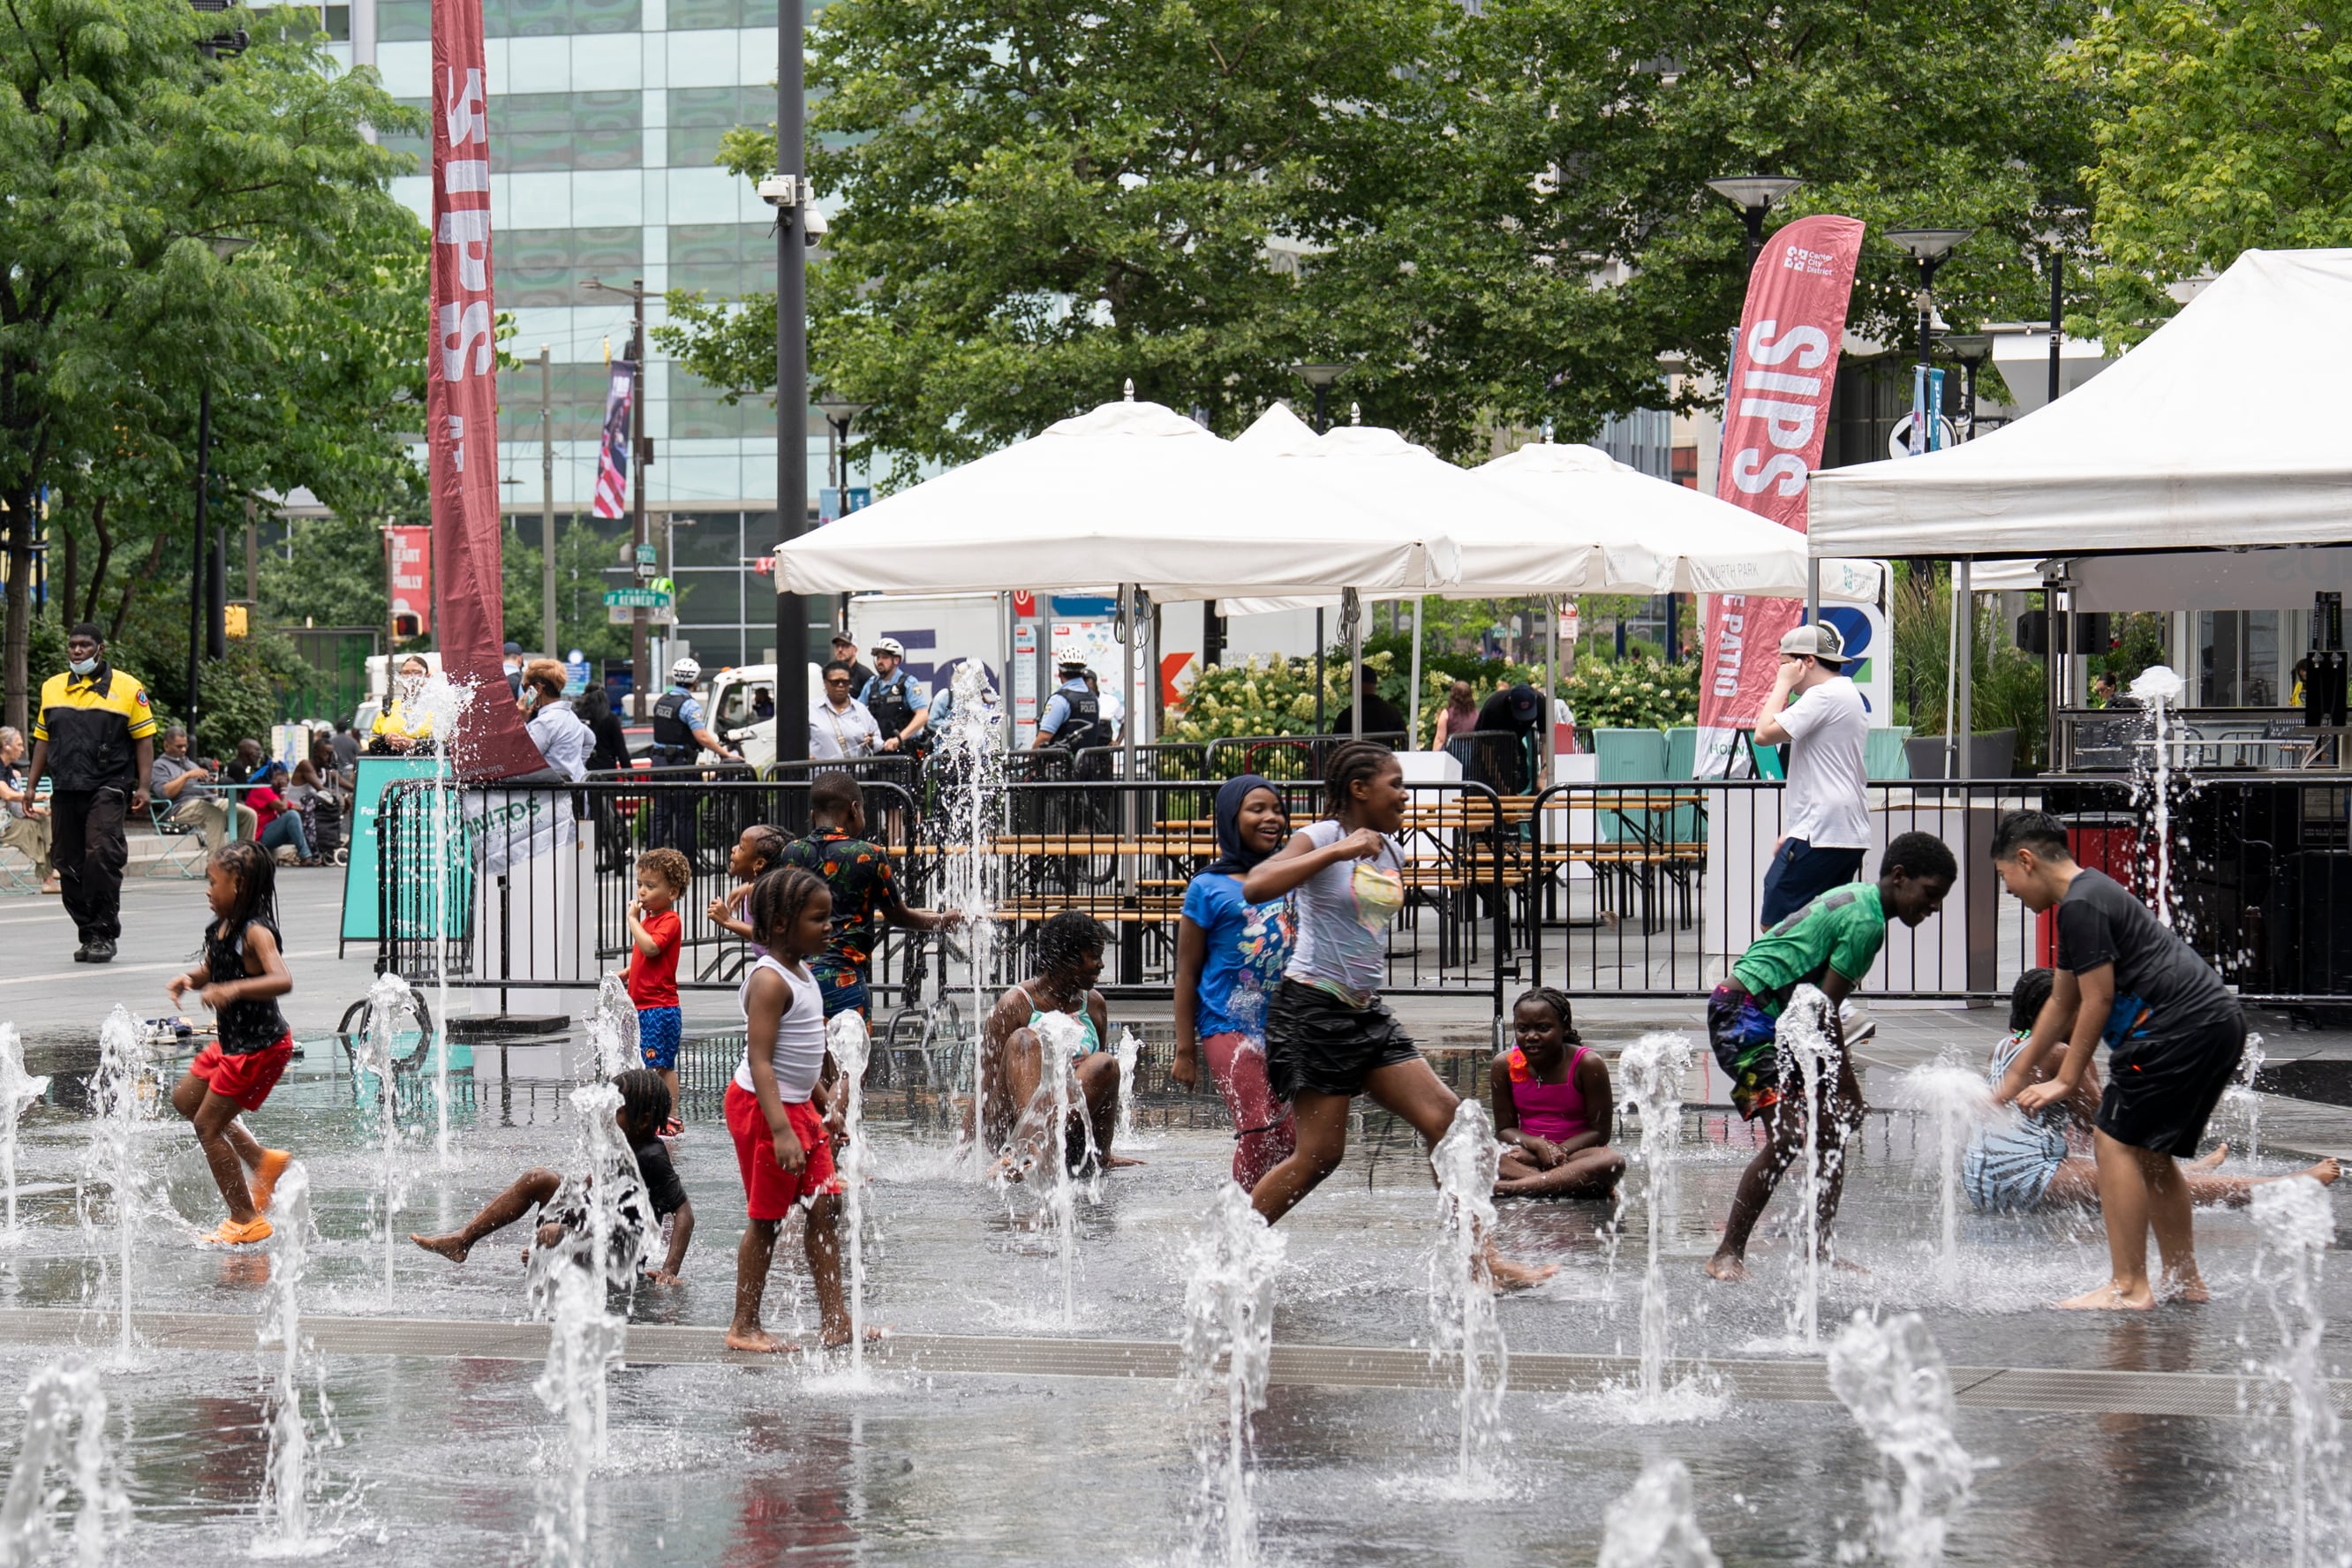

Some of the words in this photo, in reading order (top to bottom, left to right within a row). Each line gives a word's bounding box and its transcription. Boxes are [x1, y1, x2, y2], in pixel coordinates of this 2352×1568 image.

[437, 65, 492, 381] SIPS
[1809, 251, 1834, 261] Center
[1807, 259, 1823, 268] City
[1806, 266, 1833, 275] District
[1732, 319, 1829, 497] SIPS
[1738, 562, 1759, 578] PARK
[619, 594, 656, 606] KENNEDY
[1714, 613, 1745, 697] PATIO
[1081, 705, 1097, 713] POLICE
